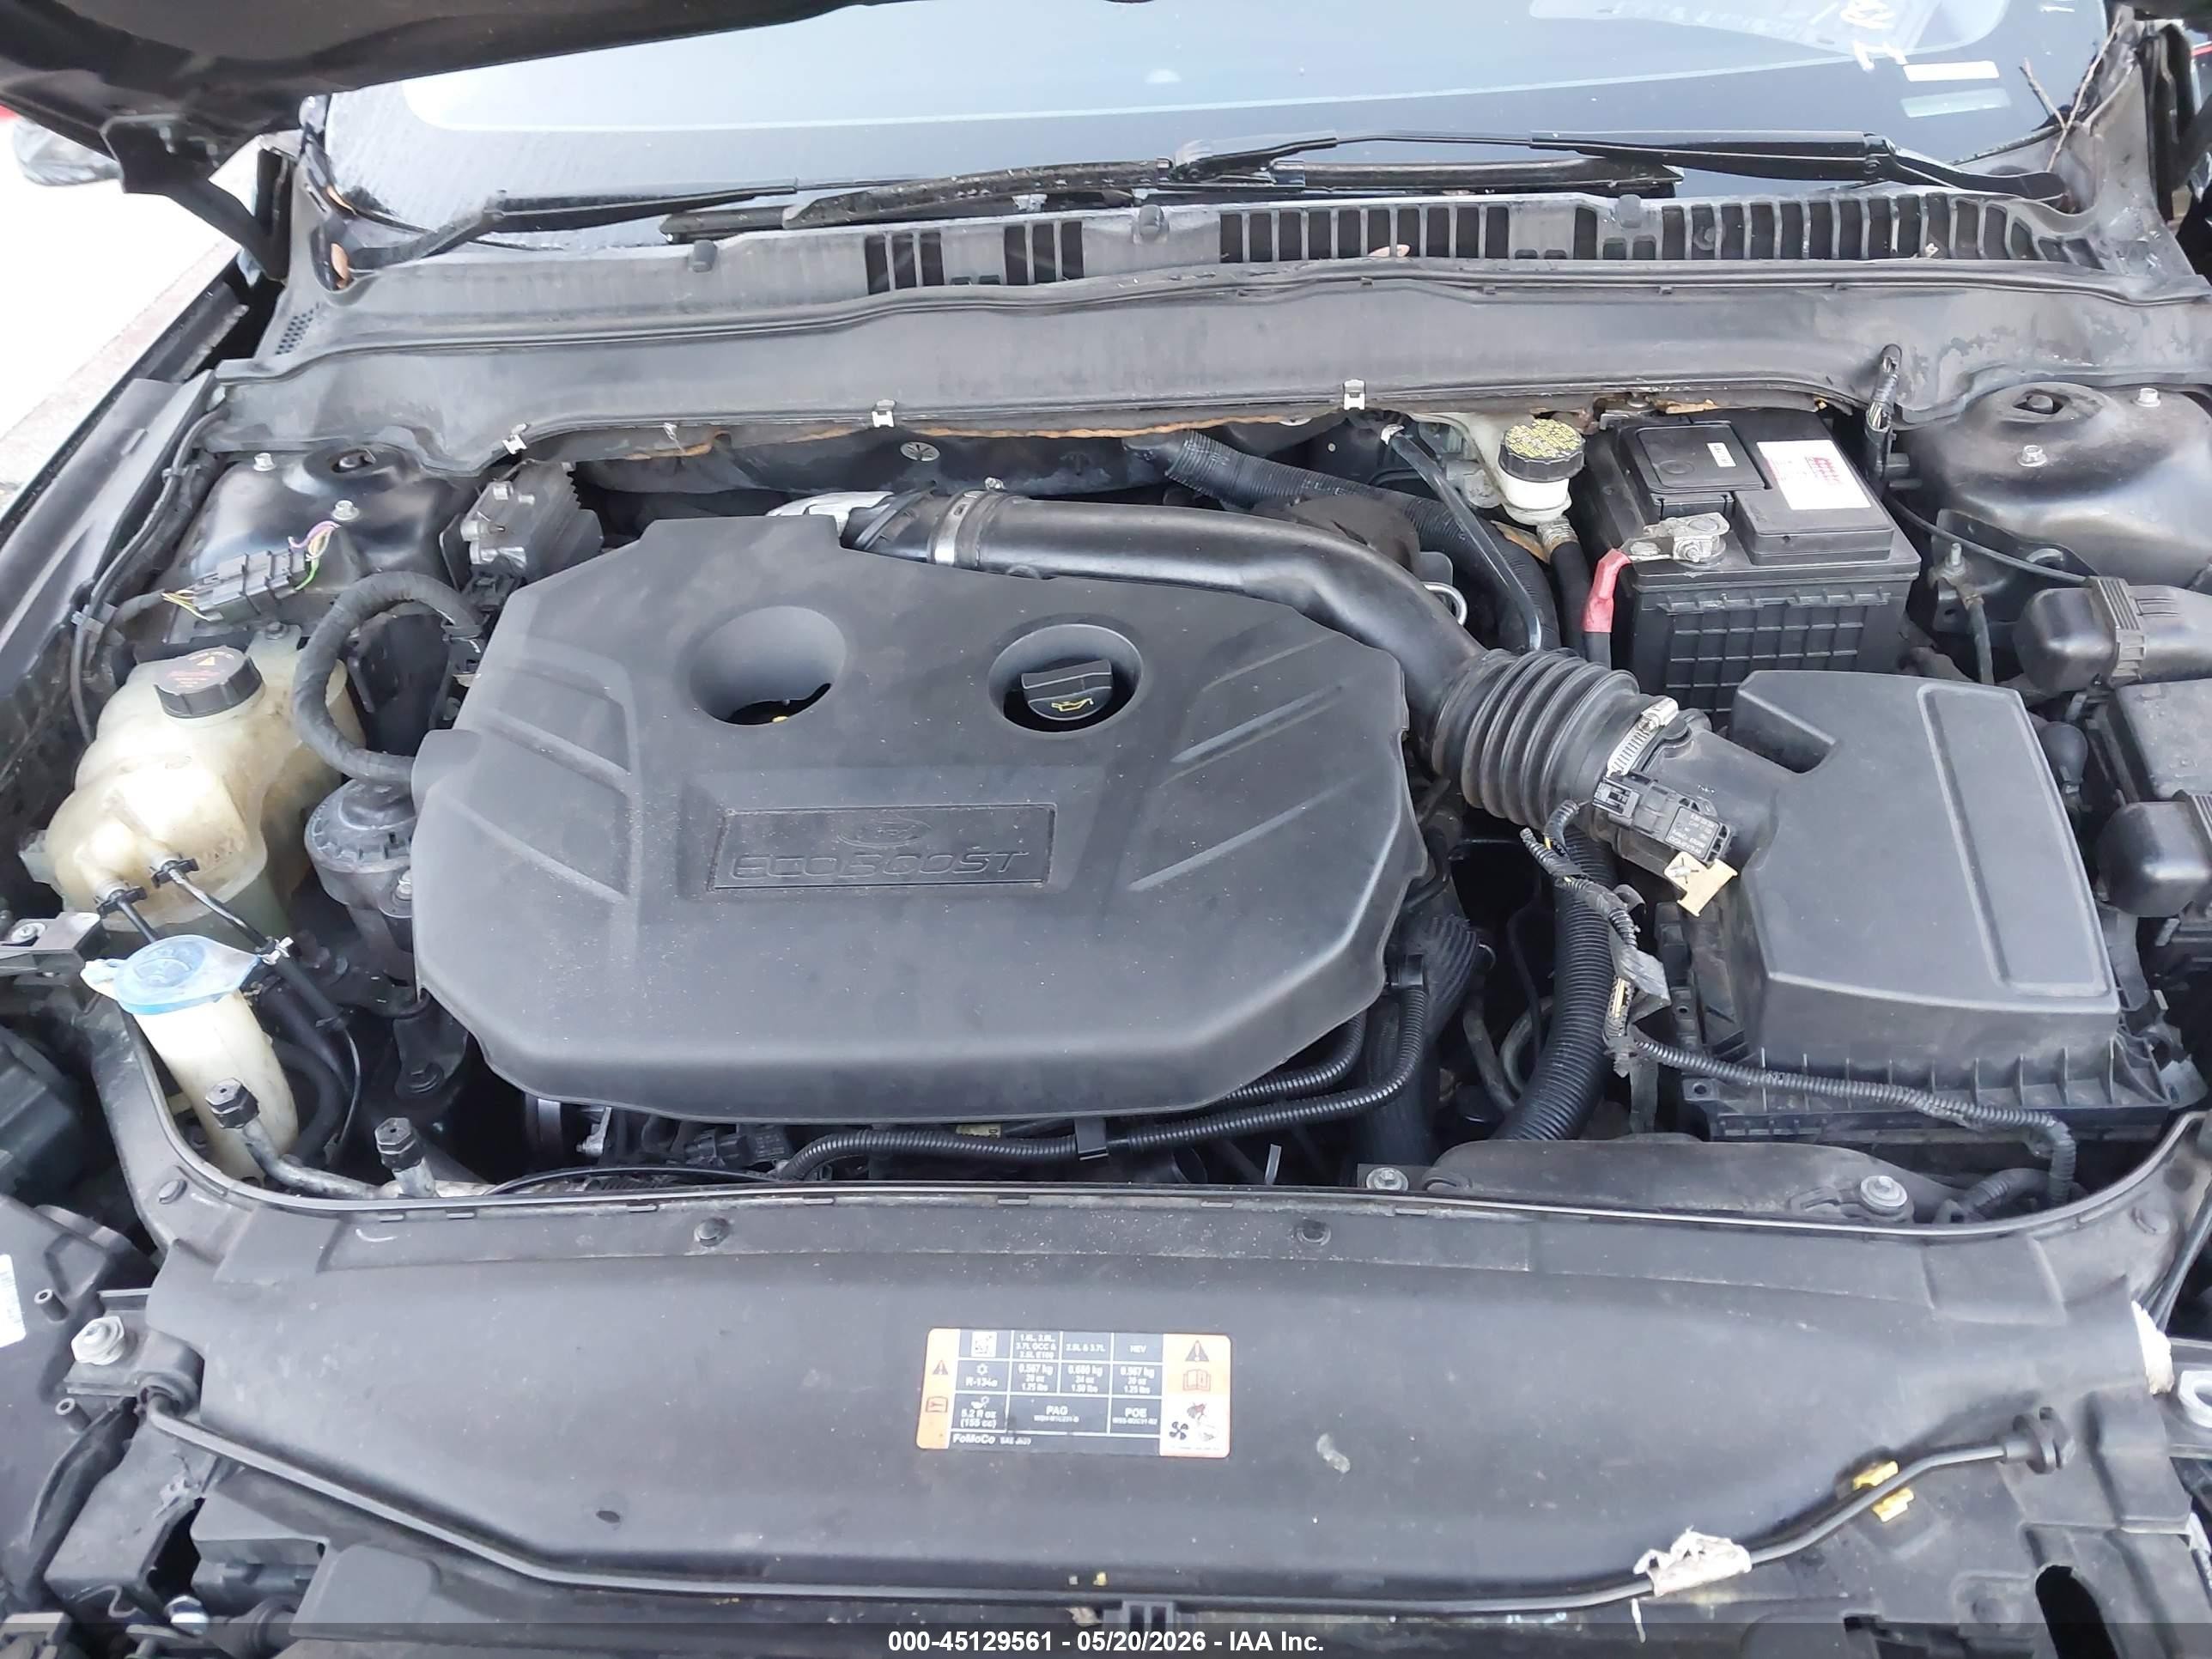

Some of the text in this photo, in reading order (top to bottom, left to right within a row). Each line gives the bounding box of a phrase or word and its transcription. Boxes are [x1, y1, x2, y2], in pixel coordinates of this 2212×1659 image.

[730, 851, 1030, 879] ECOBOOST
[1129, 1345, 1147, 1353] HEV
[1042, 1364, 1054, 1376] kg
[1091, 1365, 1103, 1377] kg
[1144, 1367, 1155, 1378] kg
[1046, 1405, 1068, 1416] PAG
[1124, 1407, 1148, 1418] POE
[952, 1433, 996, 1444] FoMoCo
